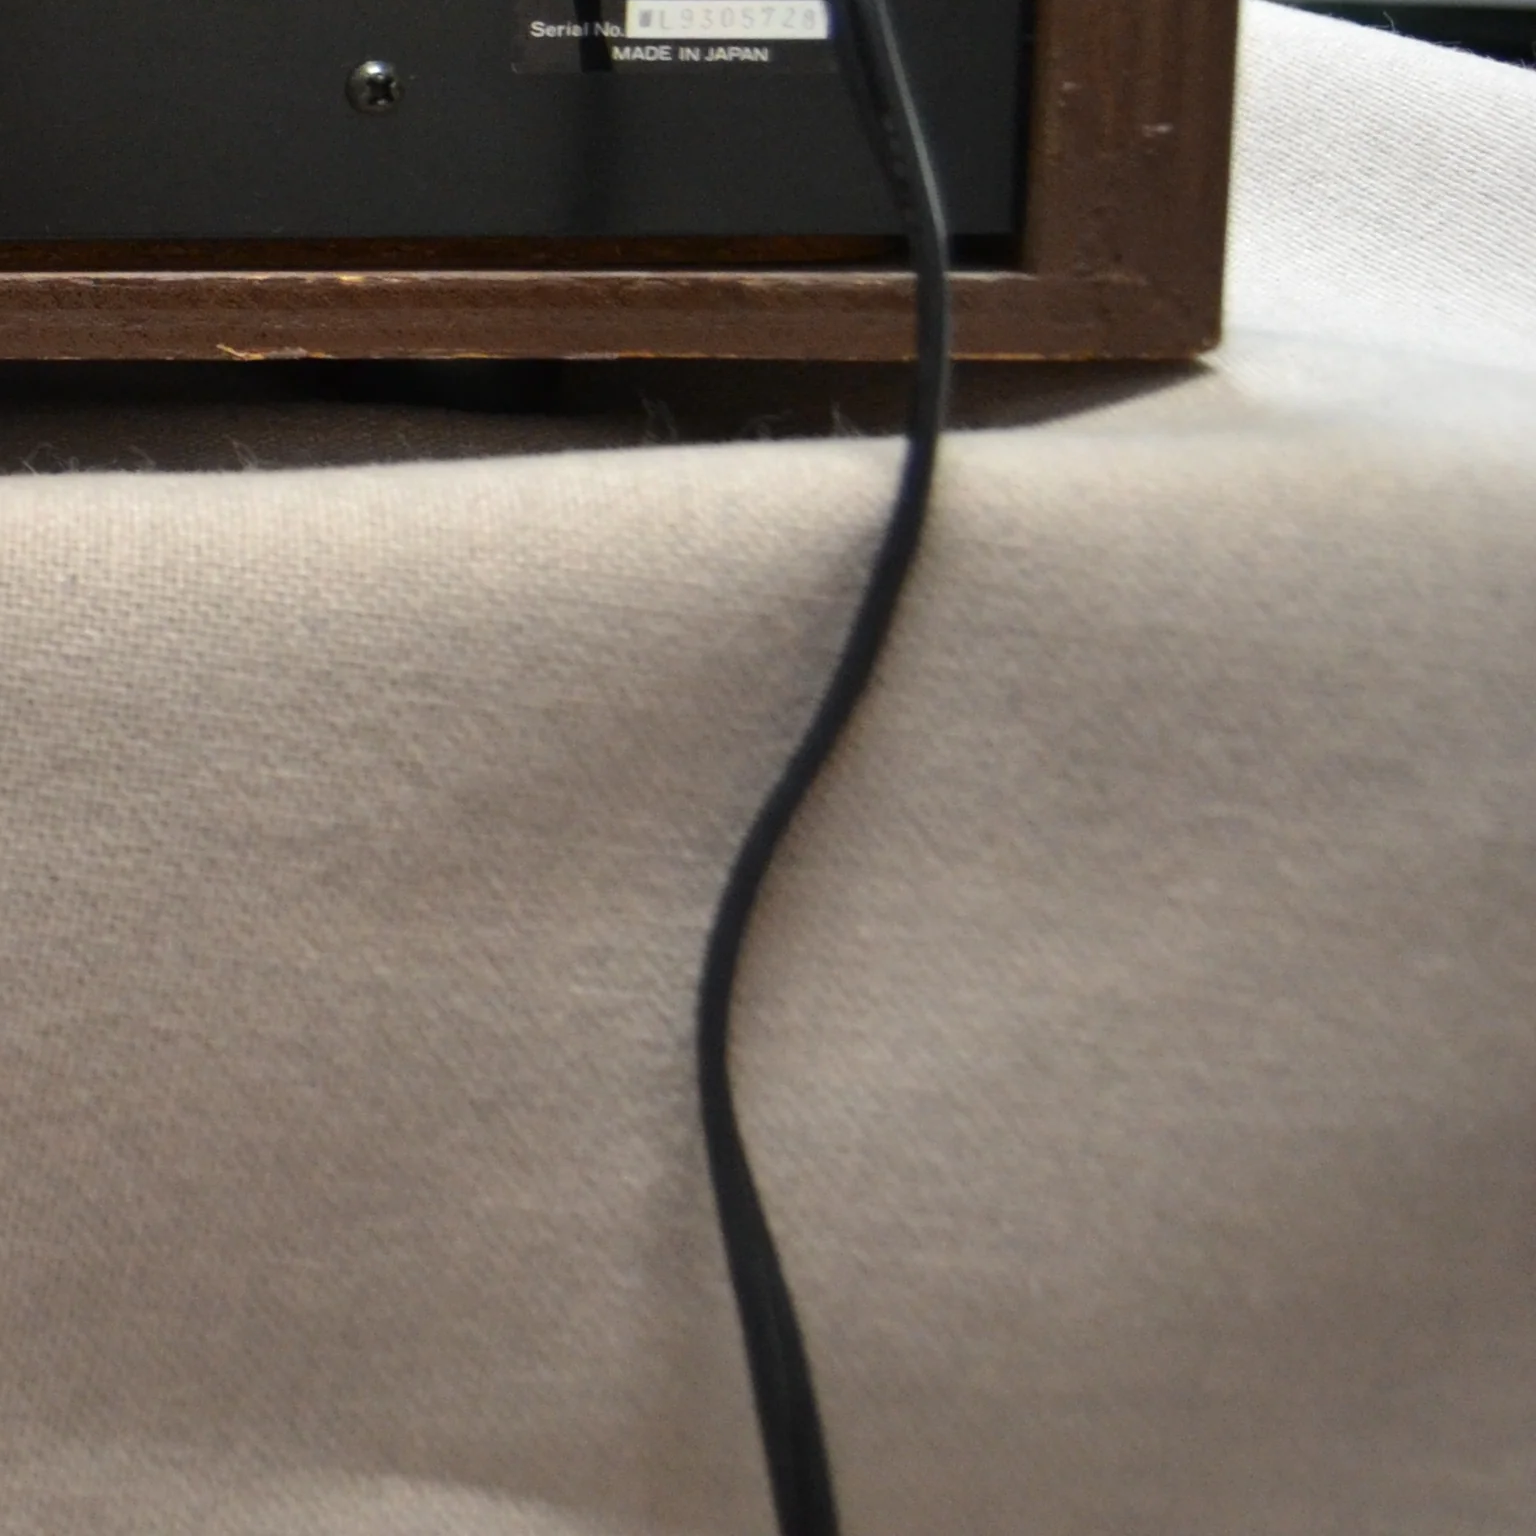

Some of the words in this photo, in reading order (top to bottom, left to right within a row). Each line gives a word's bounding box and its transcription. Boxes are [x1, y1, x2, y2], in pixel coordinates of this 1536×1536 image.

[530, 20, 590, 39] Serial
[592, 20, 626, 39] No.
[611, 45, 673, 63] MADE
[678, 46, 701, 63] IN
[704, 45, 770, 64] JAPAN
